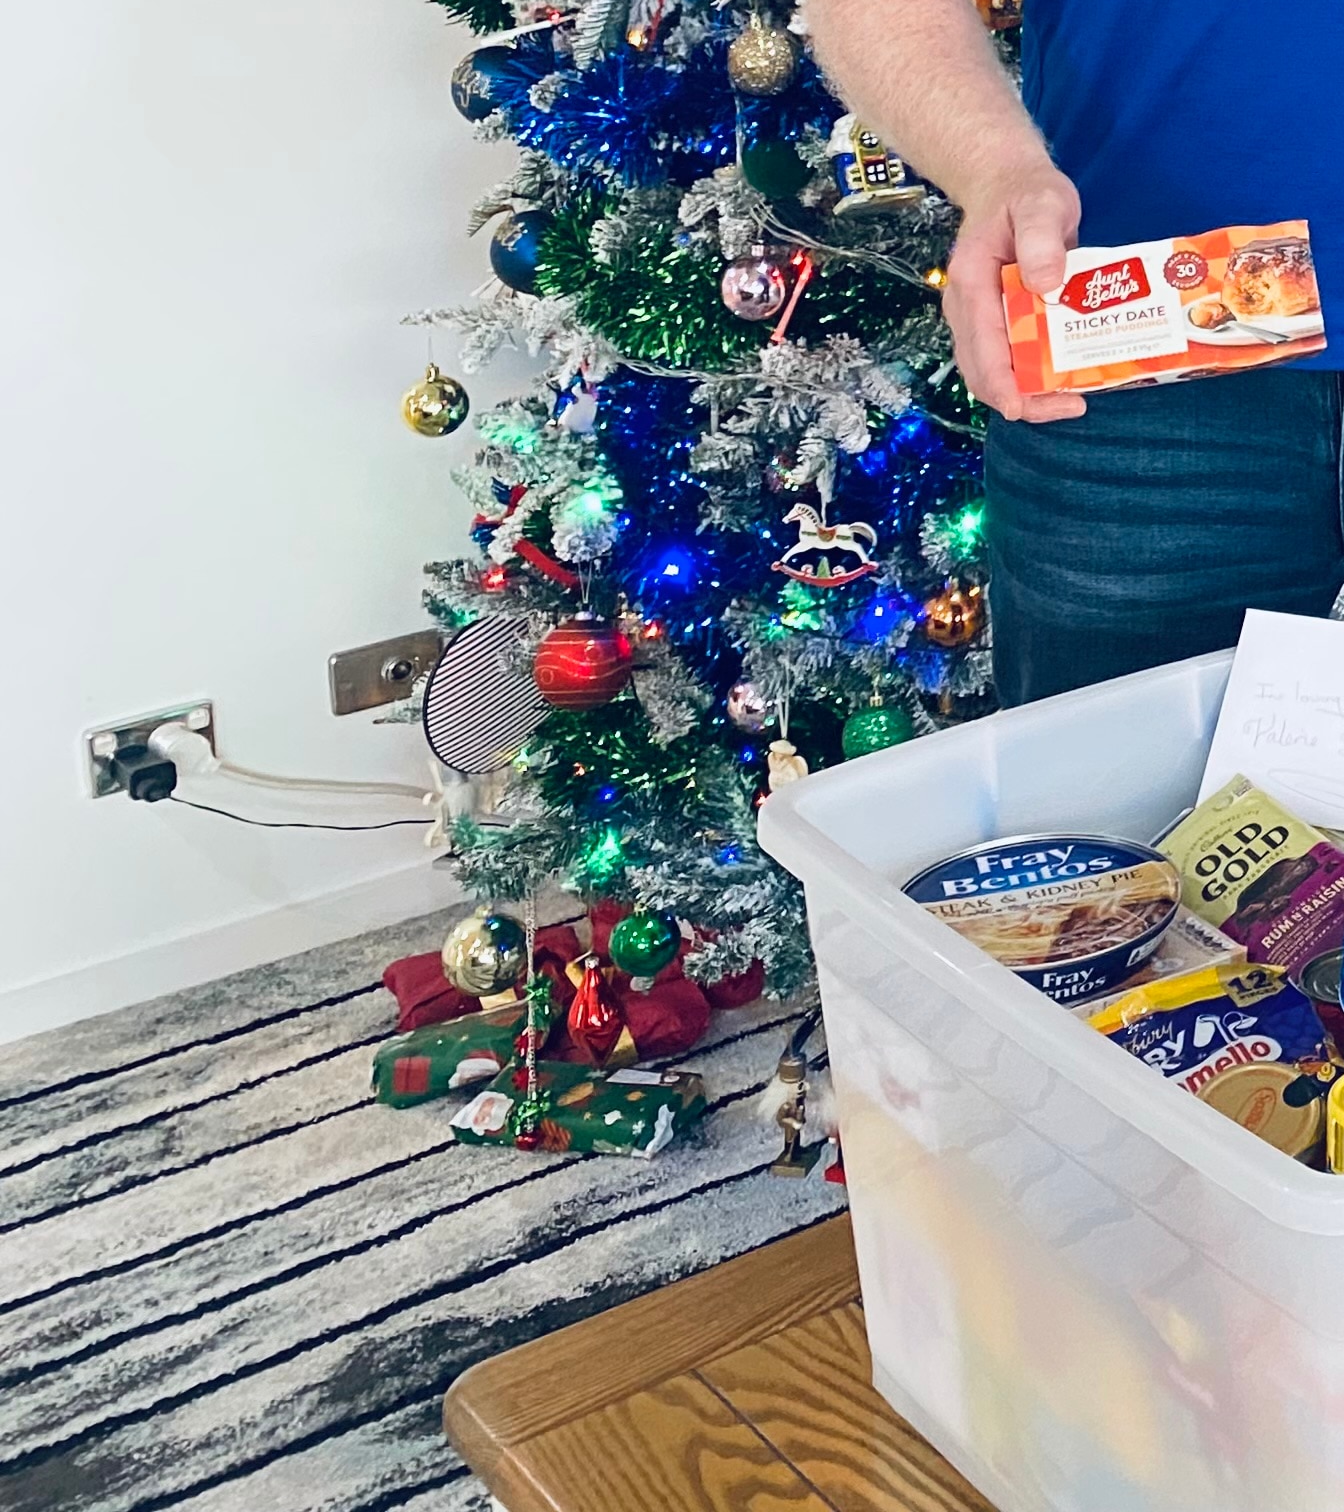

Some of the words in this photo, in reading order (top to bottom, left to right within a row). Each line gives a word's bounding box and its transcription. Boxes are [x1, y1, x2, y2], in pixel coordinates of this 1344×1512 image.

[1086, 263, 1131, 290] Aunt
[1176, 263, 1197, 278] 30
[1082, 279, 1139, 308] Betty's
[1064, 313, 1121, 333] STICKY
[1126, 305, 1167, 321] DATE
[1064, 327, 1113, 343] STEAMED
[1115, 318, 1169, 333] PUDDINGS
[1295, 680, 1344, 718] loving
[975, 845, 1076, 876] Fray
[1195, 822, 1262, 877] OLD
[1201, 826, 1289, 902] GOLD
[940, 855, 1114, 897] Bentos
[1000, 894, 1017, 904] &
[1027, 879, 1102, 900] KIDNEY
[1111, 869, 1143, 885] PIE
[1261, 920, 1295, 950] RUM
[1043, 967, 1095, 988] Fray
[1045, 976, 1106, 1000] entos
[1228, 970, 1274, 993] 12
